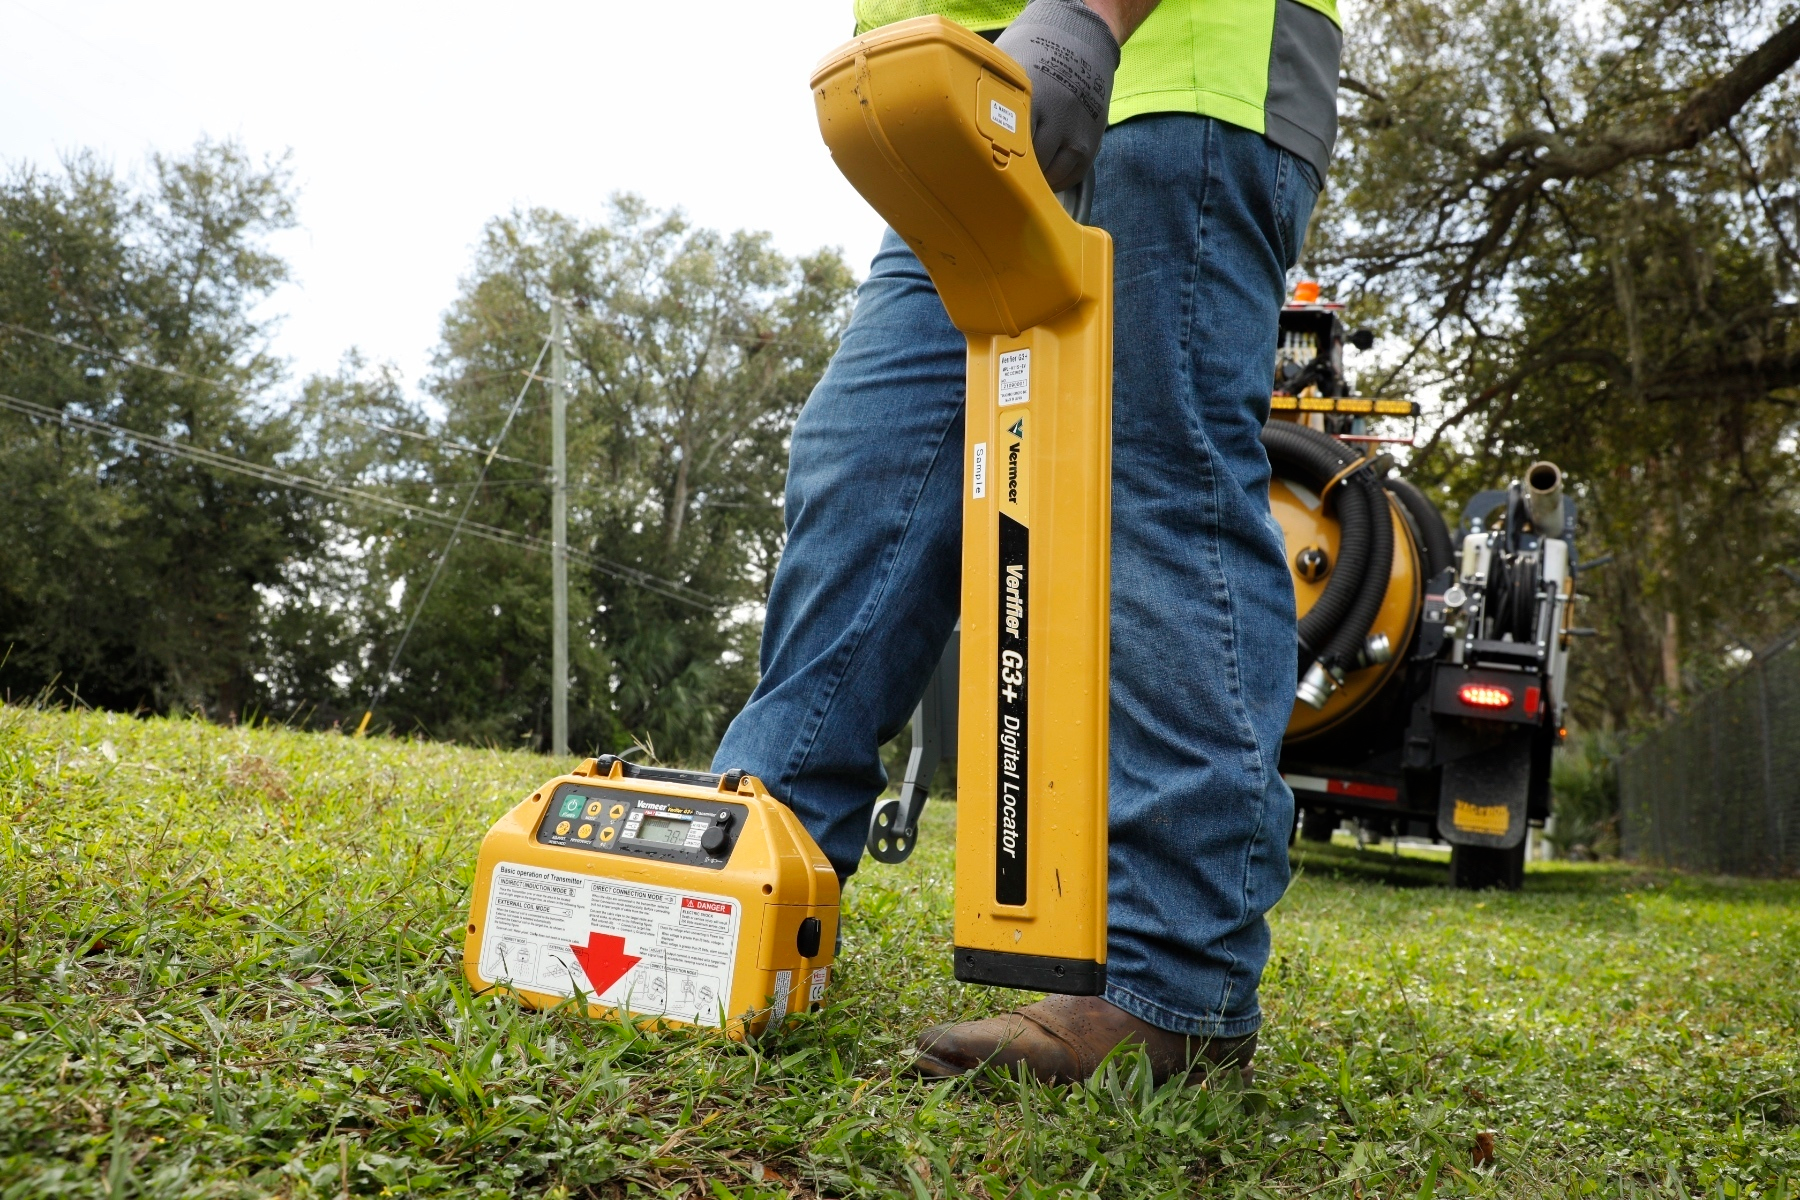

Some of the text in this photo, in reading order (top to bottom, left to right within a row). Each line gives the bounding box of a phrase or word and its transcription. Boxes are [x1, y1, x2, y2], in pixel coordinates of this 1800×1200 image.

[1040, 66, 1078, 93] Guard
[974, 448, 984, 494] Sample
[1008, 442, 1021, 504] Vermeer
[1000, 564, 1024, 859] Verifier G3+ Digital Locator
[637, 800, 668, 811] Vermeer
[500, 866, 516, 875] Basic
[517, 870, 543, 879] operation
[551, 873, 583, 885] Transmitter
[500, 879, 523, 887] INDIRECT
[552, 886, 568, 895] MODE
[592, 884, 611, 892] DIRECT
[612, 888, 647, 898] CONNECTION
[647, 893, 663, 901] MODE
[697, 901, 725, 912] DANGER
